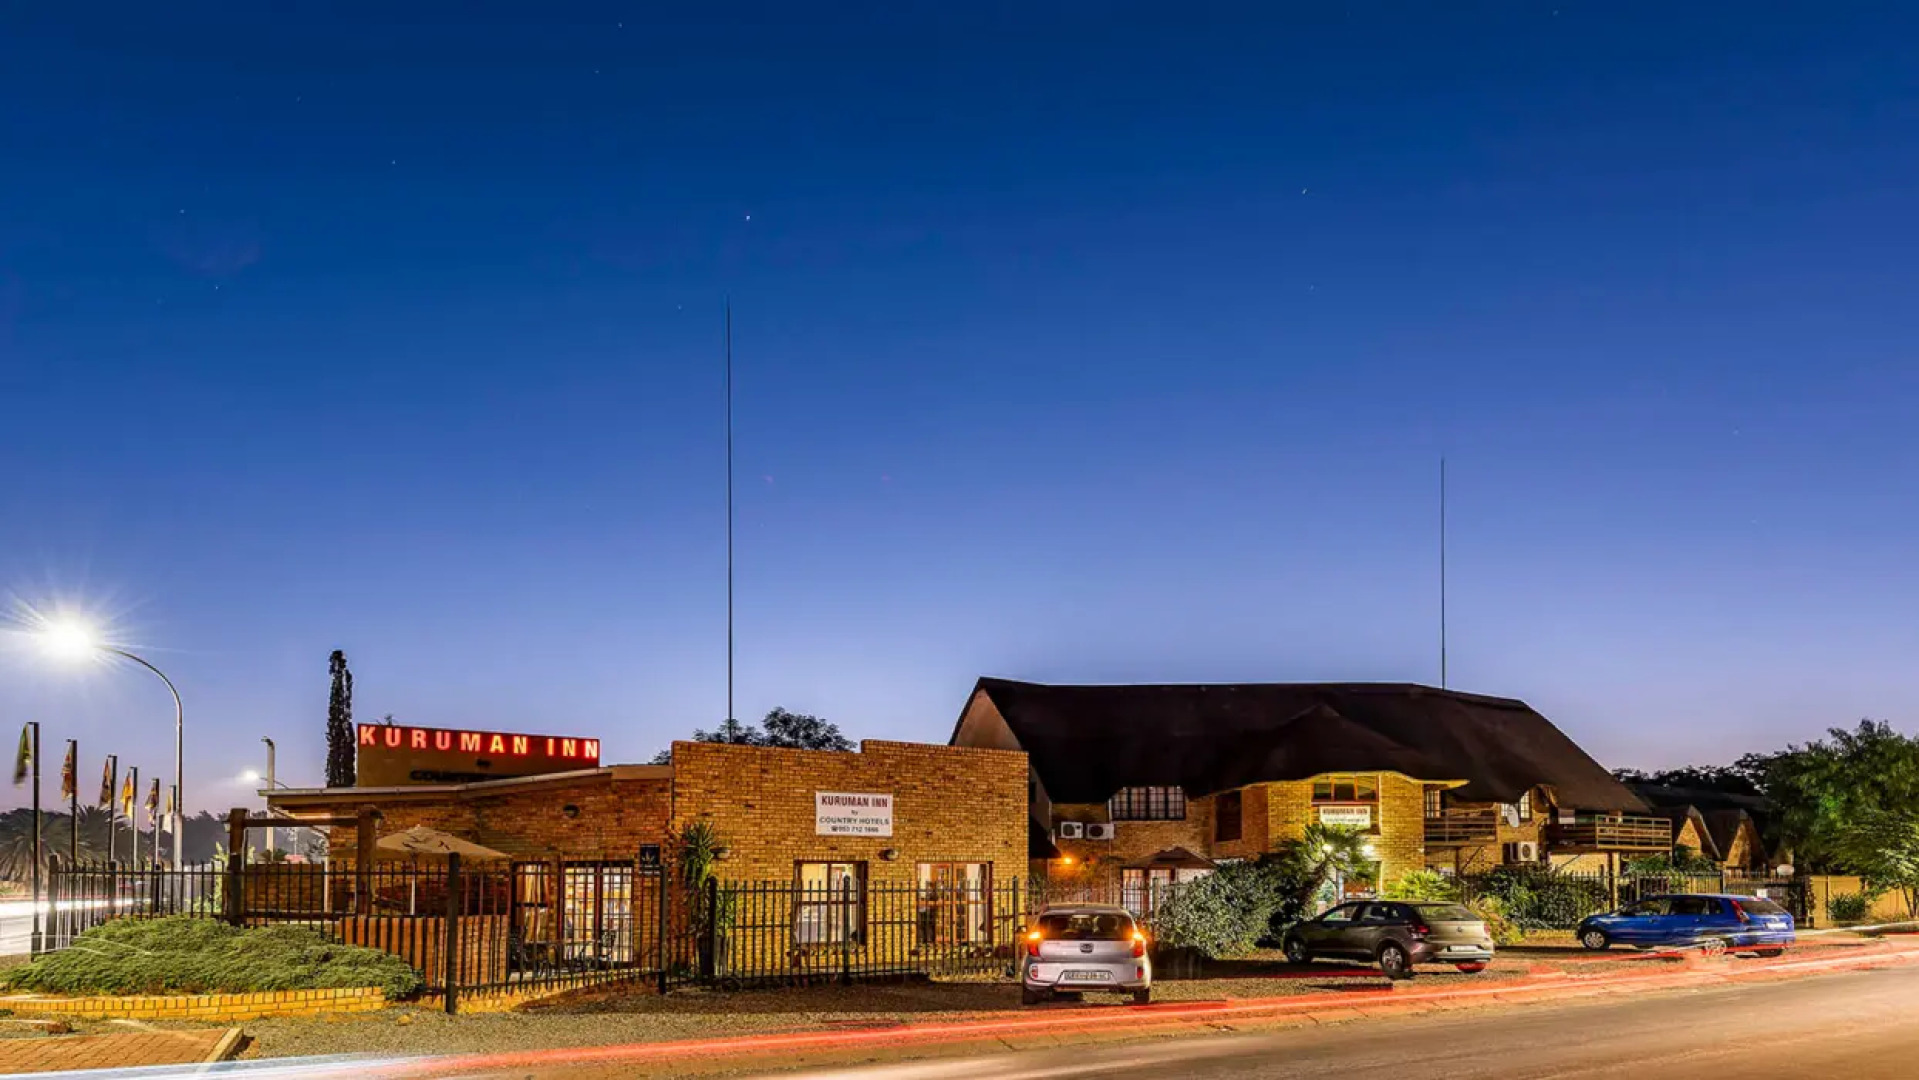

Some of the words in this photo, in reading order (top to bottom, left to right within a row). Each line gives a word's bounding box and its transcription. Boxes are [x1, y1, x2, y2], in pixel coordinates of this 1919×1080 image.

[360, 725, 527, 754] KURUMAN
[547, 738, 598, 758] INN
[821, 795, 869, 807] KURUMAN
[872, 797, 888, 808] INN
[819, 816, 857, 825] COUNTRY
[859, 817, 889, 825] HOTELS
